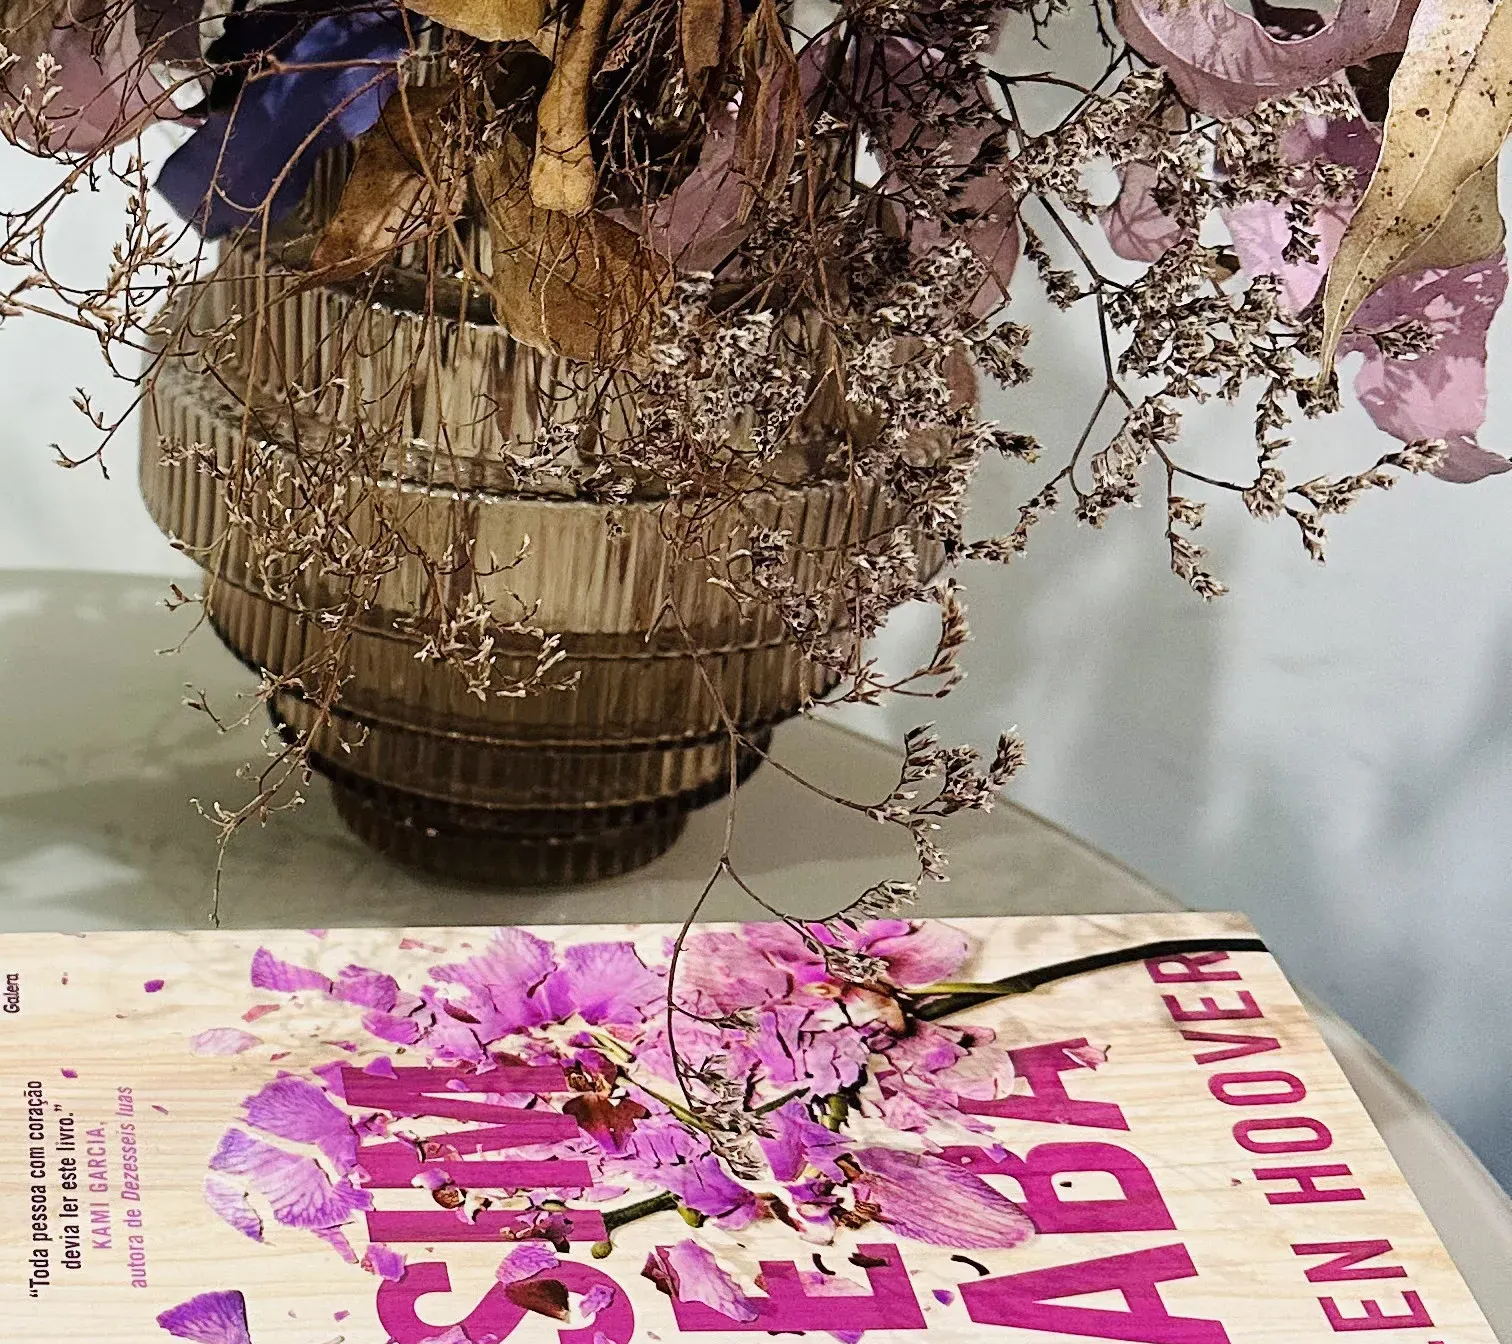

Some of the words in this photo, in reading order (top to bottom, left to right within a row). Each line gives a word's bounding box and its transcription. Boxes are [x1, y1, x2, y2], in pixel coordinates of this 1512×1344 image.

[2, 972, 21, 1014] Galera
[1143, 950, 1366, 1206] HOOVER
[23, 1080, 48, 1141] coração
[115, 1086, 135, 1117] luas
[29, 1146, 46, 1179] com
[57, 1157, 78, 1191] este
[85, 1121, 109, 1193] GARCIA,
[115, 1122, 141, 1202] Dezesseis
[30, 1185, 54, 1242] pessoa
[58, 1196, 79, 1218] ler
[89, 1202, 112, 1249] KAMI
[122, 1208, 143, 1228] de
[58, 1225, 82, 1270] devia
[127, 1235, 148, 1289] autora
